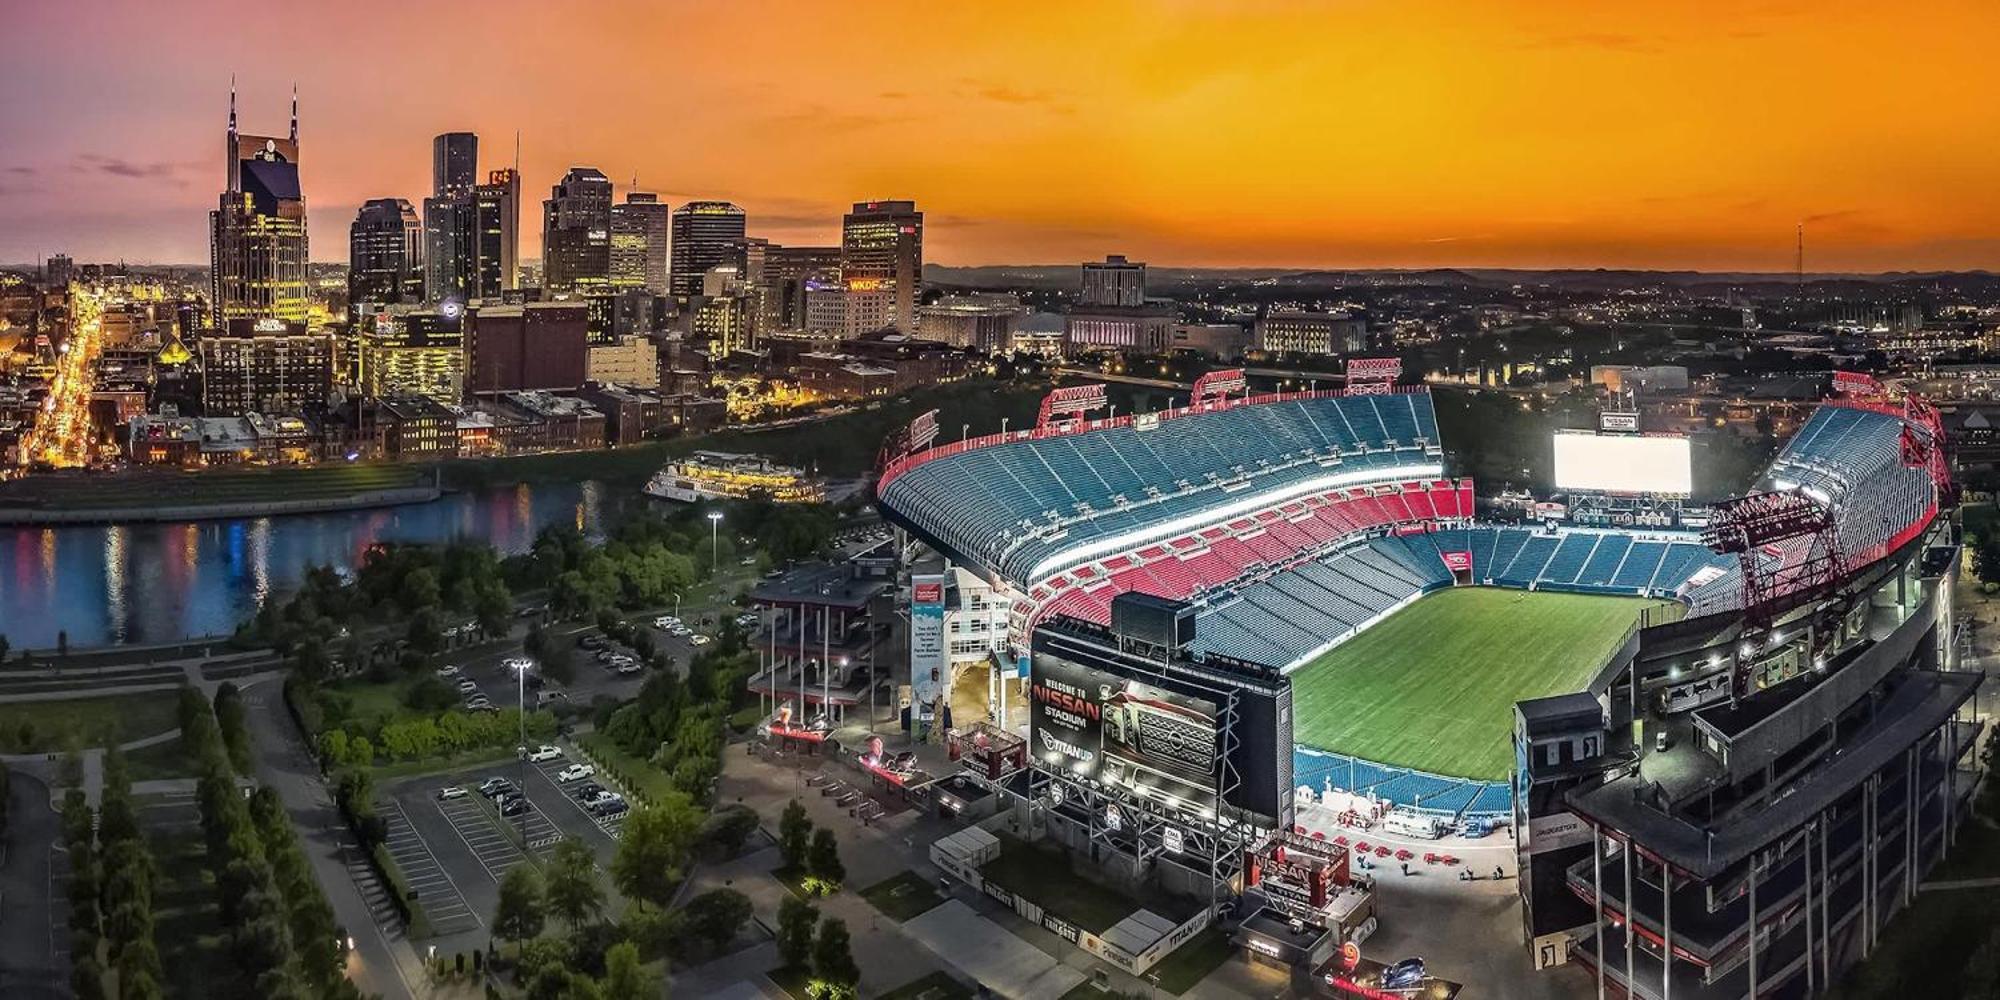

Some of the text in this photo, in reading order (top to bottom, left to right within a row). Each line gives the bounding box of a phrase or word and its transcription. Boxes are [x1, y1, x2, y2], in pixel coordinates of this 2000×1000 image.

[850, 280, 880, 291] WKDF
[1045, 678, 1087, 699] WELCOME TO
[1033, 684, 1100, 721] NISSAN
[1045, 705, 1087, 729] STADIUM
[1253, 854, 1311, 884] NISSAN
